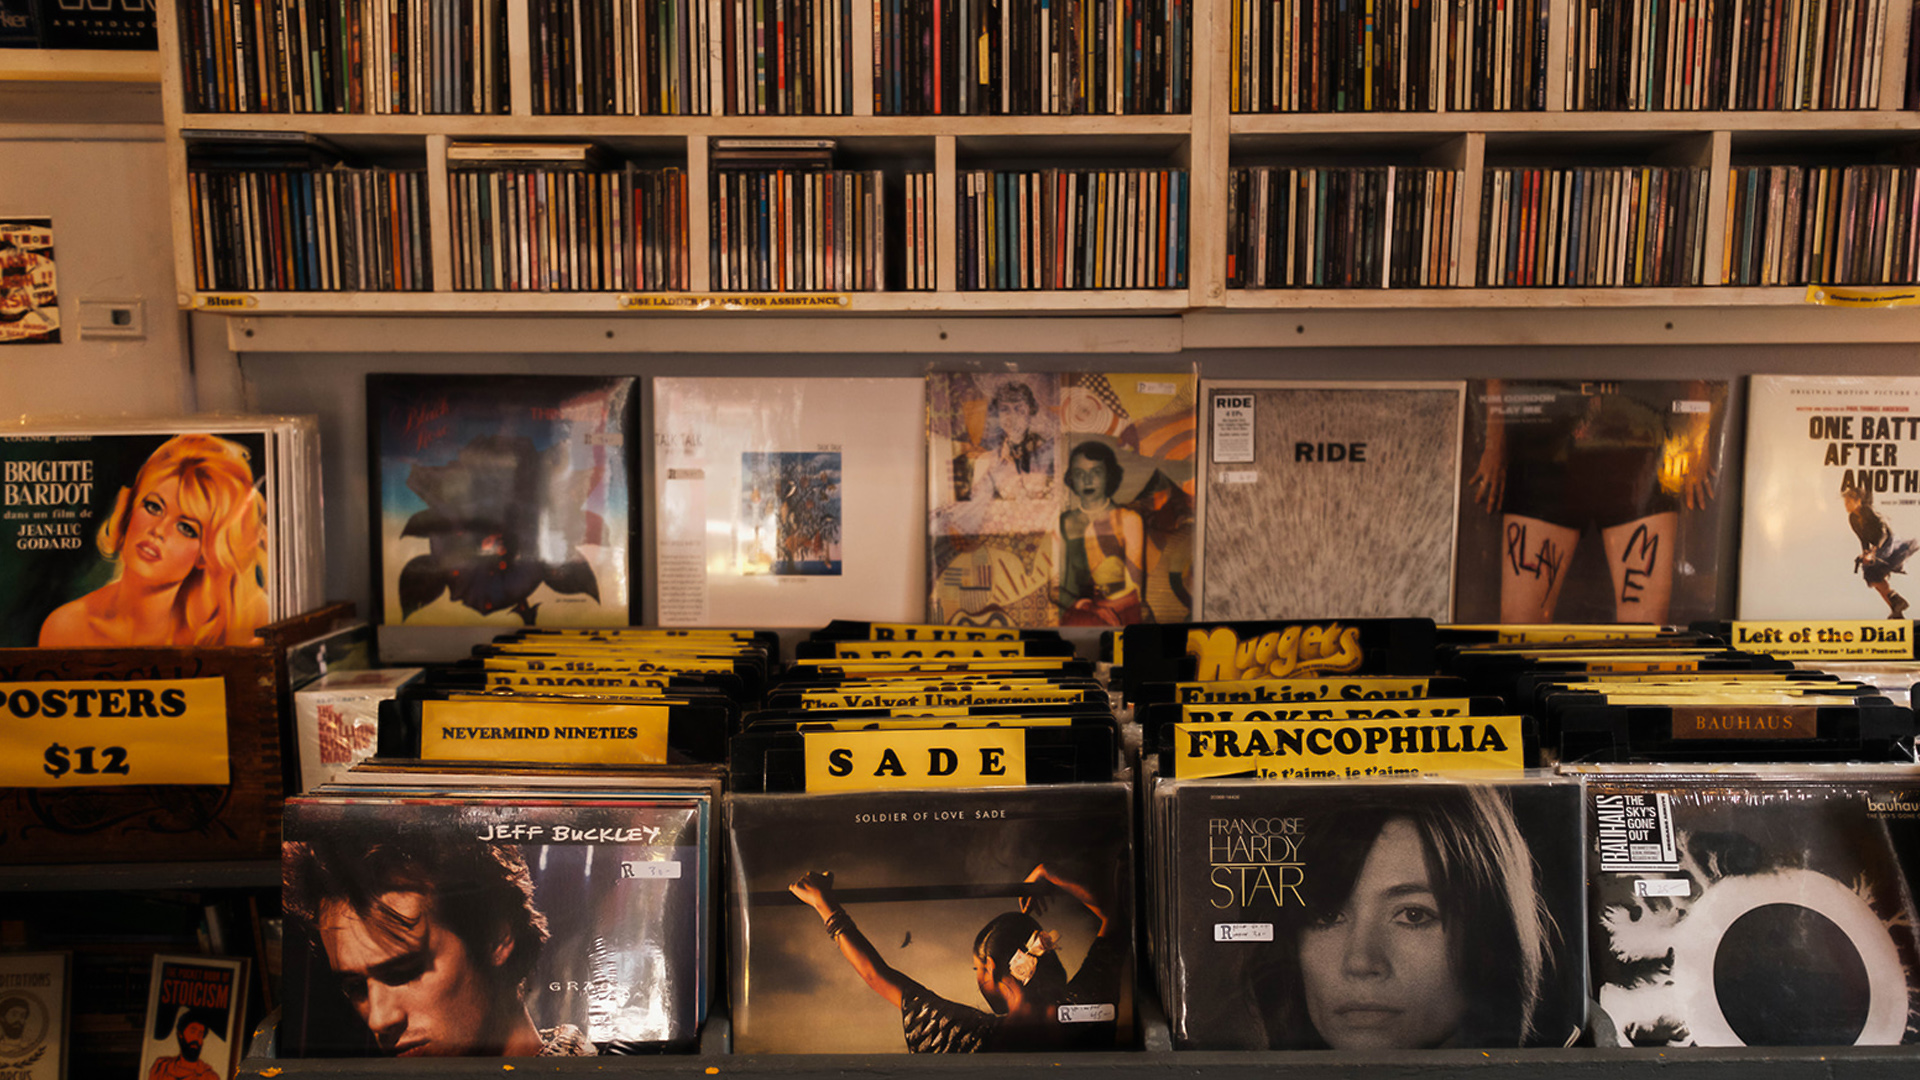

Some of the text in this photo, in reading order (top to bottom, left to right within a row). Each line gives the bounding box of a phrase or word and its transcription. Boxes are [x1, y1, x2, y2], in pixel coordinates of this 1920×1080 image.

[206, 296, 244, 307] Blues
[629, 297, 649, 306] USE
[653, 297, 698, 306] LADDER
[719, 297, 742, 306] ASK
[744, 297, 767, 305] FOR
[769, 296, 840, 305] ASSISTANCE
[1216, 397, 1252, 408] RIDE
[1490, 406, 1521, 415] PLAY
[1809, 415, 1854, 440] ONE
[1294, 442, 1368, 462] RIDE
[1824, 442, 1898, 466] AFTER
[4, 460, 94, 482] BRIGITTE
[1840, 469, 1920, 493] ANOTH
[4, 483, 93, 506] BARDOT
[4, 509, 93, 519] dans un film de
[17, 523, 81, 537] JEAN-LUC
[16, 537, 82, 550] GODARD
[1507, 522, 1565, 609] PLAY
[1738, 626, 1906, 643] Left of the Dial
[0, 688, 187, 718] OSTERS
[1696, 715, 1793, 730] BAUHAUS
[442, 727, 638, 740] NEVERMIND NINETIES
[1187, 724, 1509, 758] FRANCOPHILIA
[43, 742, 130, 779] $12
[828, 747, 1007, 777] SADE
[1624, 795, 1645, 806] THE
[1867, 797, 1920, 811] bauhau
[855, 809, 1007, 823] SOLDIER OF LOVE SADE
[1625, 806, 1657, 818] SKY'S
[1595, 795, 1630, 862] BAUHAUS
[1627, 818, 1656, 829] GONE
[478, 824, 661, 844] JEFF BUCKLEY
[1628, 830, 1649, 841] OUT
[1209, 835, 1306, 863] HARDY
[621, 862, 635, 878] R
[1210, 866, 1306, 909] STAR
[1638, 881, 1648, 896] R
[1220, 925, 1233, 939] R
[161, 978, 230, 1009] STOICISM
[1060, 1007, 1072, 1021] R
